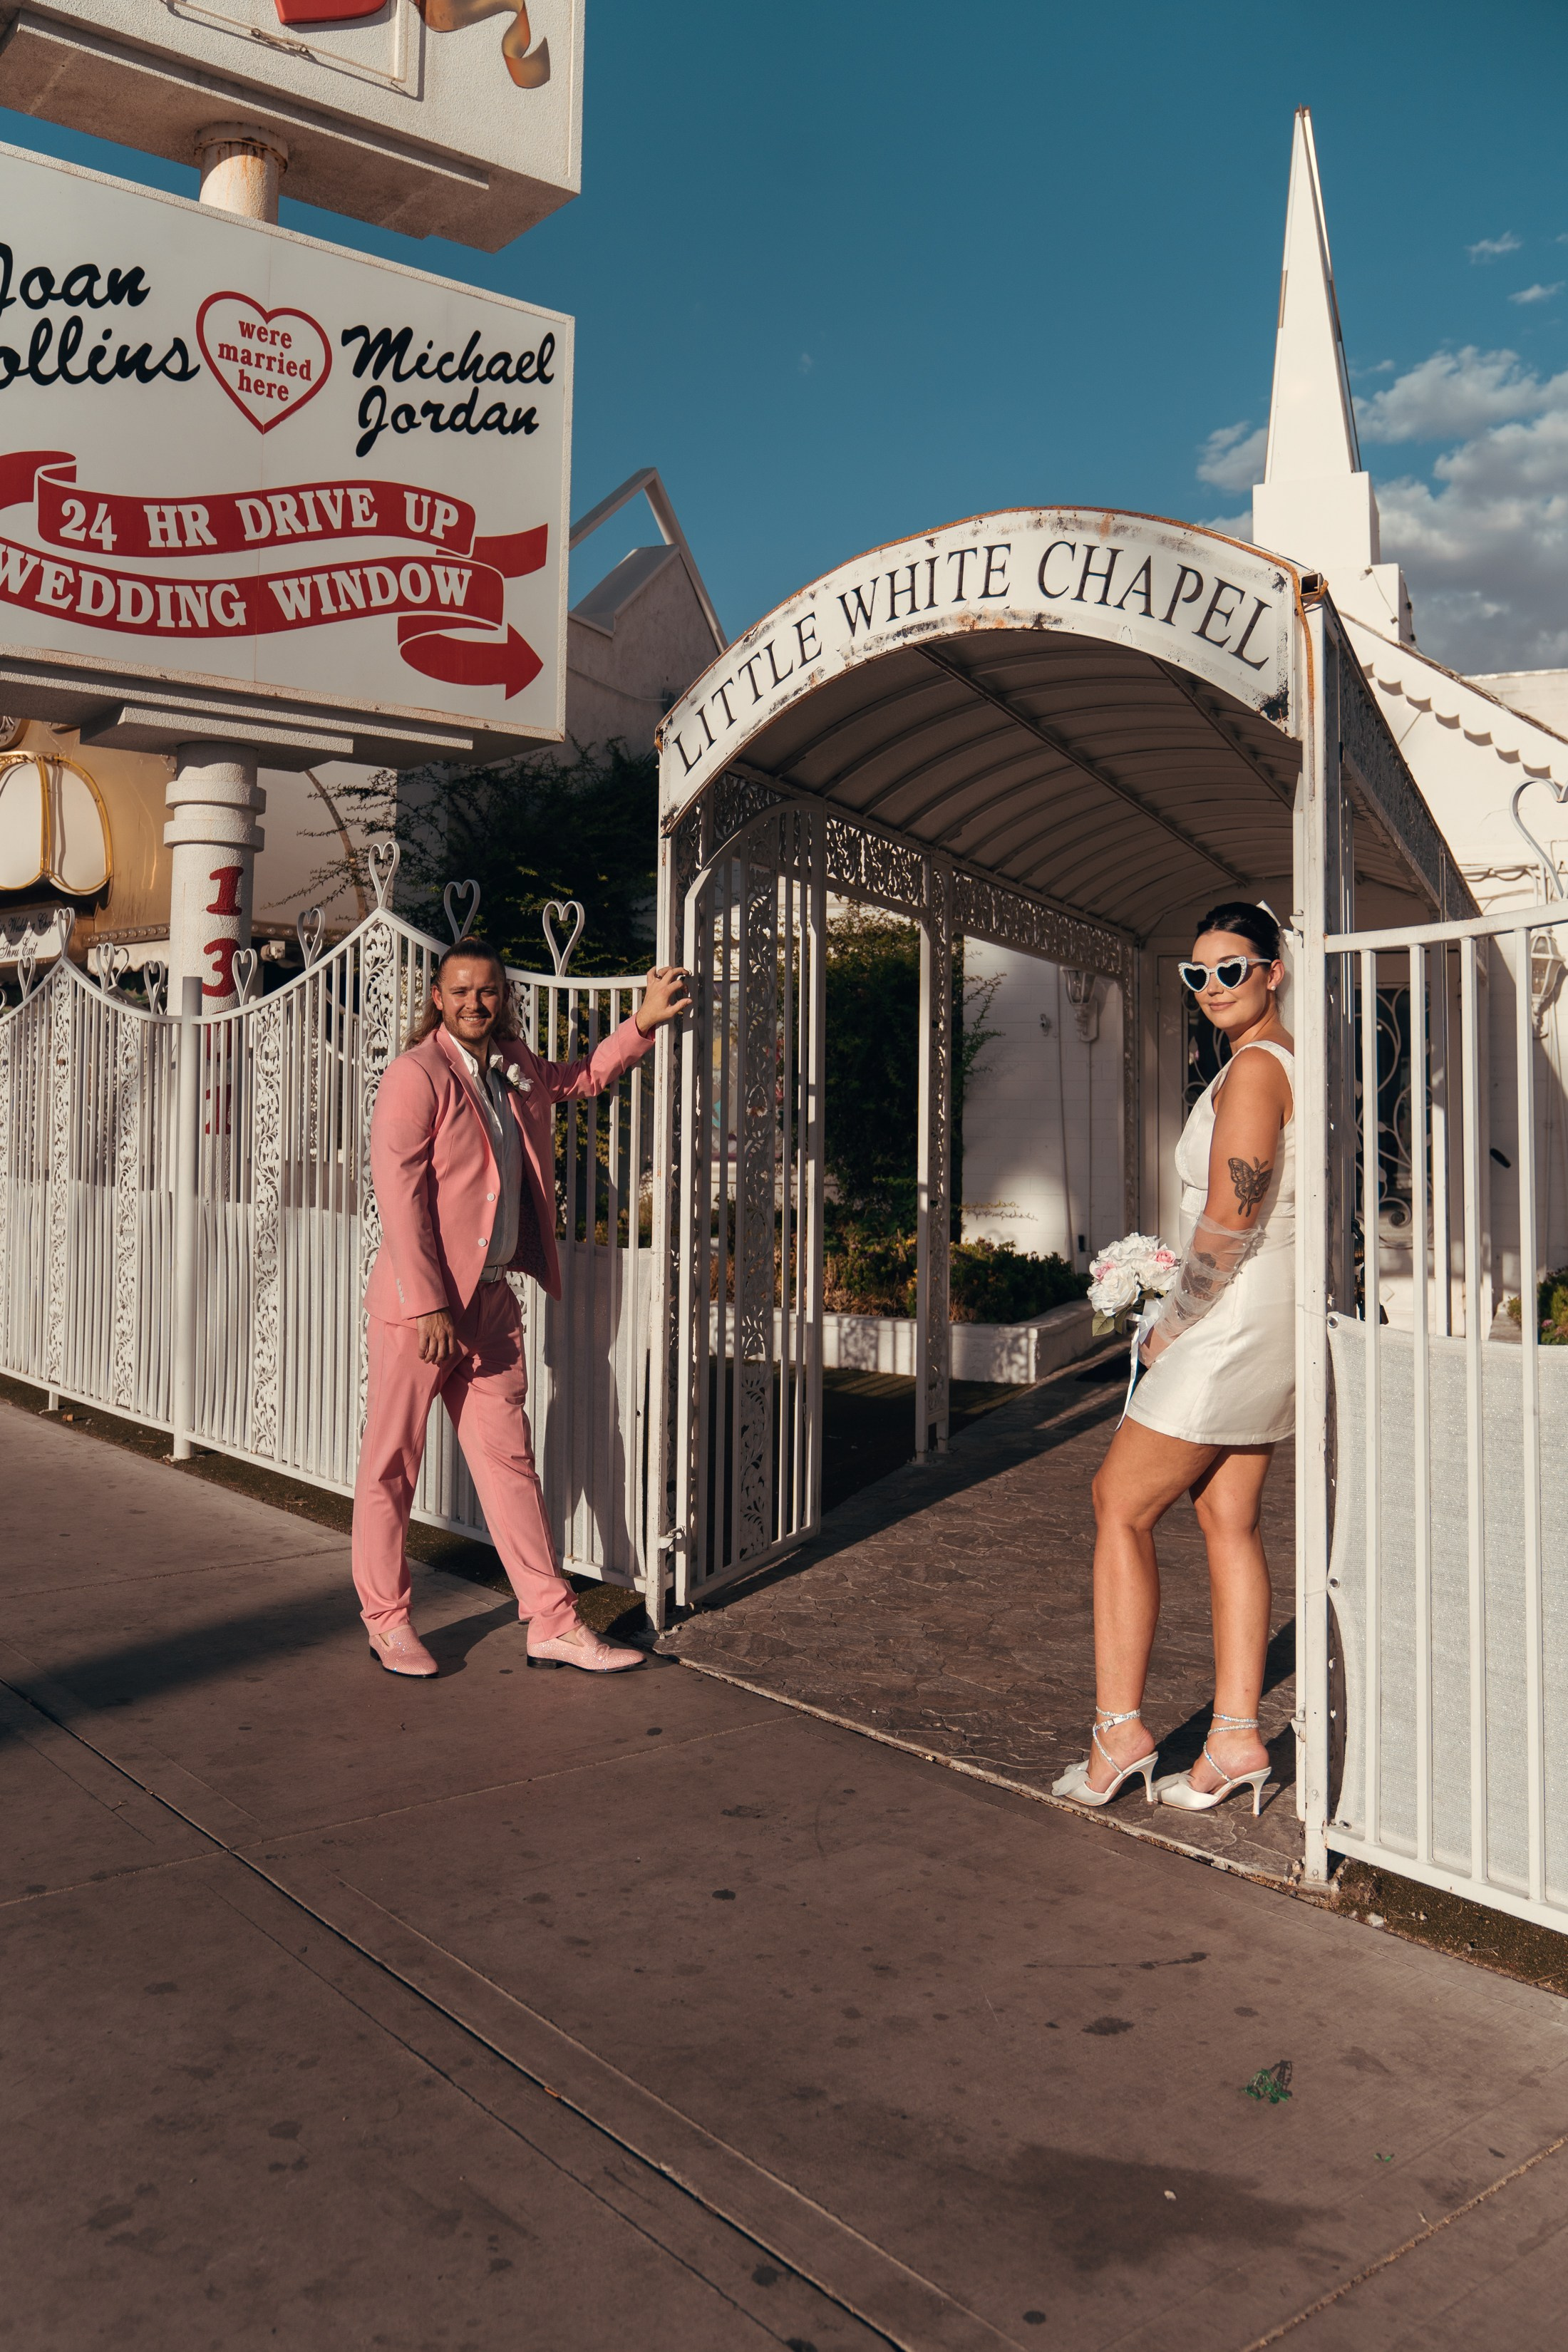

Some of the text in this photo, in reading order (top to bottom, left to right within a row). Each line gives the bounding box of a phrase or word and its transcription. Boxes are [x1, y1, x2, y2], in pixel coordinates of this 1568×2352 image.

[239, 321, 292, 349] were
[341, 325, 555, 385] Michael
[218, 343, 311, 381] married
[238, 369, 289, 402] here
[356, 385, 540, 458] Jordan
[59, 488, 459, 551] 24 HR DRIVE UP
[0, 544, 473, 627] WEDDING WINDOW
[672, 540, 1273, 777] LITTLE WHITE CHAPEL
[22, 937, 38, 956] Exit
[37, 912, 58, 934] Chape
